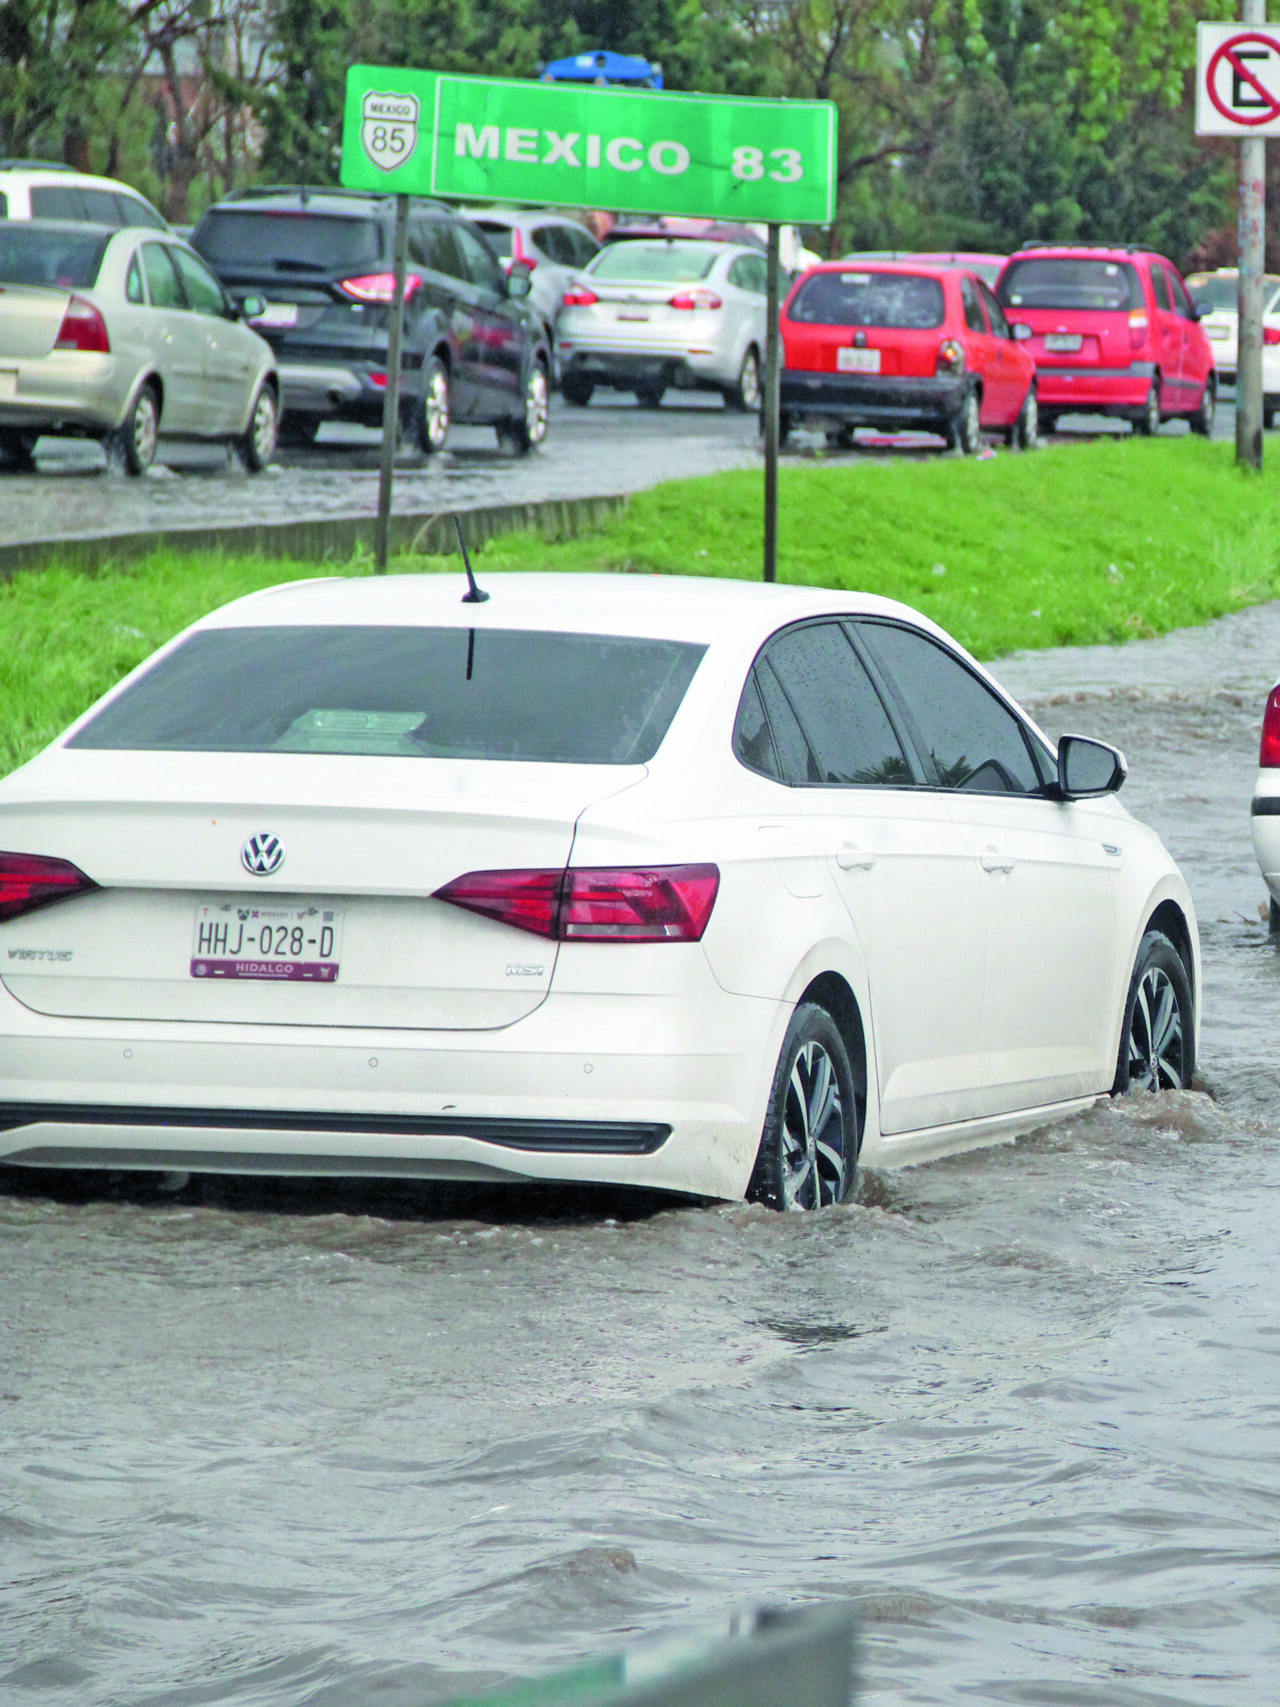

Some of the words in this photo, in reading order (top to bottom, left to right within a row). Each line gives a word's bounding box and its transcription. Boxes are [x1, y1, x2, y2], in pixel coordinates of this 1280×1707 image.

[370, 103, 410, 115] MEXICO
[371, 125, 405, 153] 85
[455, 122, 691, 176] MEXICO
[731, 146, 804, 183] 83
[198, 922, 334, 958] HHJ-028-D
[7, 949, 73, 961] VIRTUS
[235, 962, 294, 974] HIDALGO
[505, 963, 544, 976] MSI
